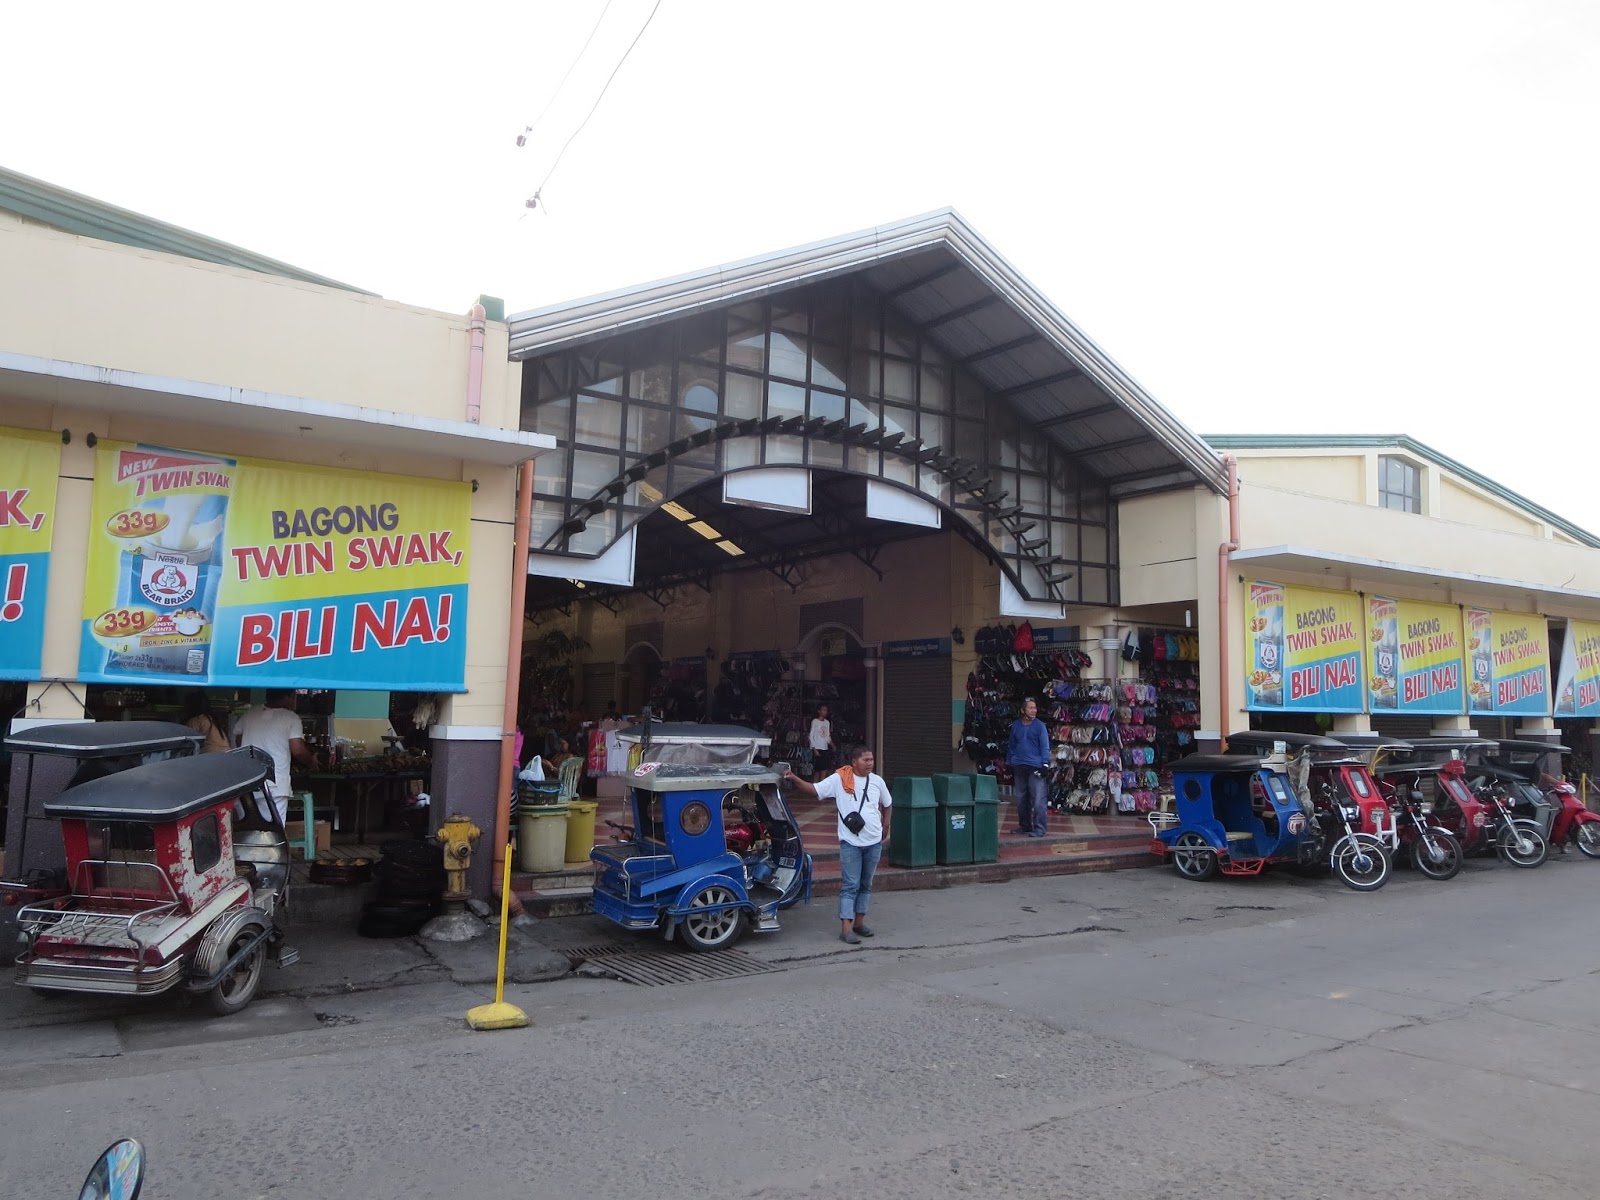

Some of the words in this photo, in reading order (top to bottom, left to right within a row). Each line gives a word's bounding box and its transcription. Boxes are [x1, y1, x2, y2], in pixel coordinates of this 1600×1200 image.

[122, 458, 158, 477] NEW
[136, 471, 194, 496] TWIN
[196, 471, 230, 489] SWAK
[116, 511, 157, 533] 33g
[271, 502, 399, 539] BAGONG
[231, 540, 334, 581] TWIN
[348, 530, 463, 572] SWAK,
[141, 583, 163, 604] BEAR
[164, 588, 194, 605] BRAND
[104, 609, 146, 632] 33g
[235, 605, 338, 668] BILI
[350, 593, 453, 653] NA!
[1296, 606, 1335, 629] BAGONG
[1407, 618, 1440, 639] BAGONG
[1286, 629, 1317, 653] TWIN
[1320, 621, 1357, 645] SWAK,
[1400, 640, 1425, 660] TWIN
[1428, 631, 1458, 653] SWAK,
[1500, 627, 1528, 647] BAGONG
[1493, 648, 1516, 666] TWIN
[1518, 640, 1543, 660] SWAK,
[1291, 665, 1320, 700] BILI
[1325, 656, 1357, 691] NA!
[1404, 671, 1428, 703] BILI
[1431, 663, 1458, 695] NA!
[1497, 676, 1519, 707] BILI
[1521, 668, 1544, 698] NA!
